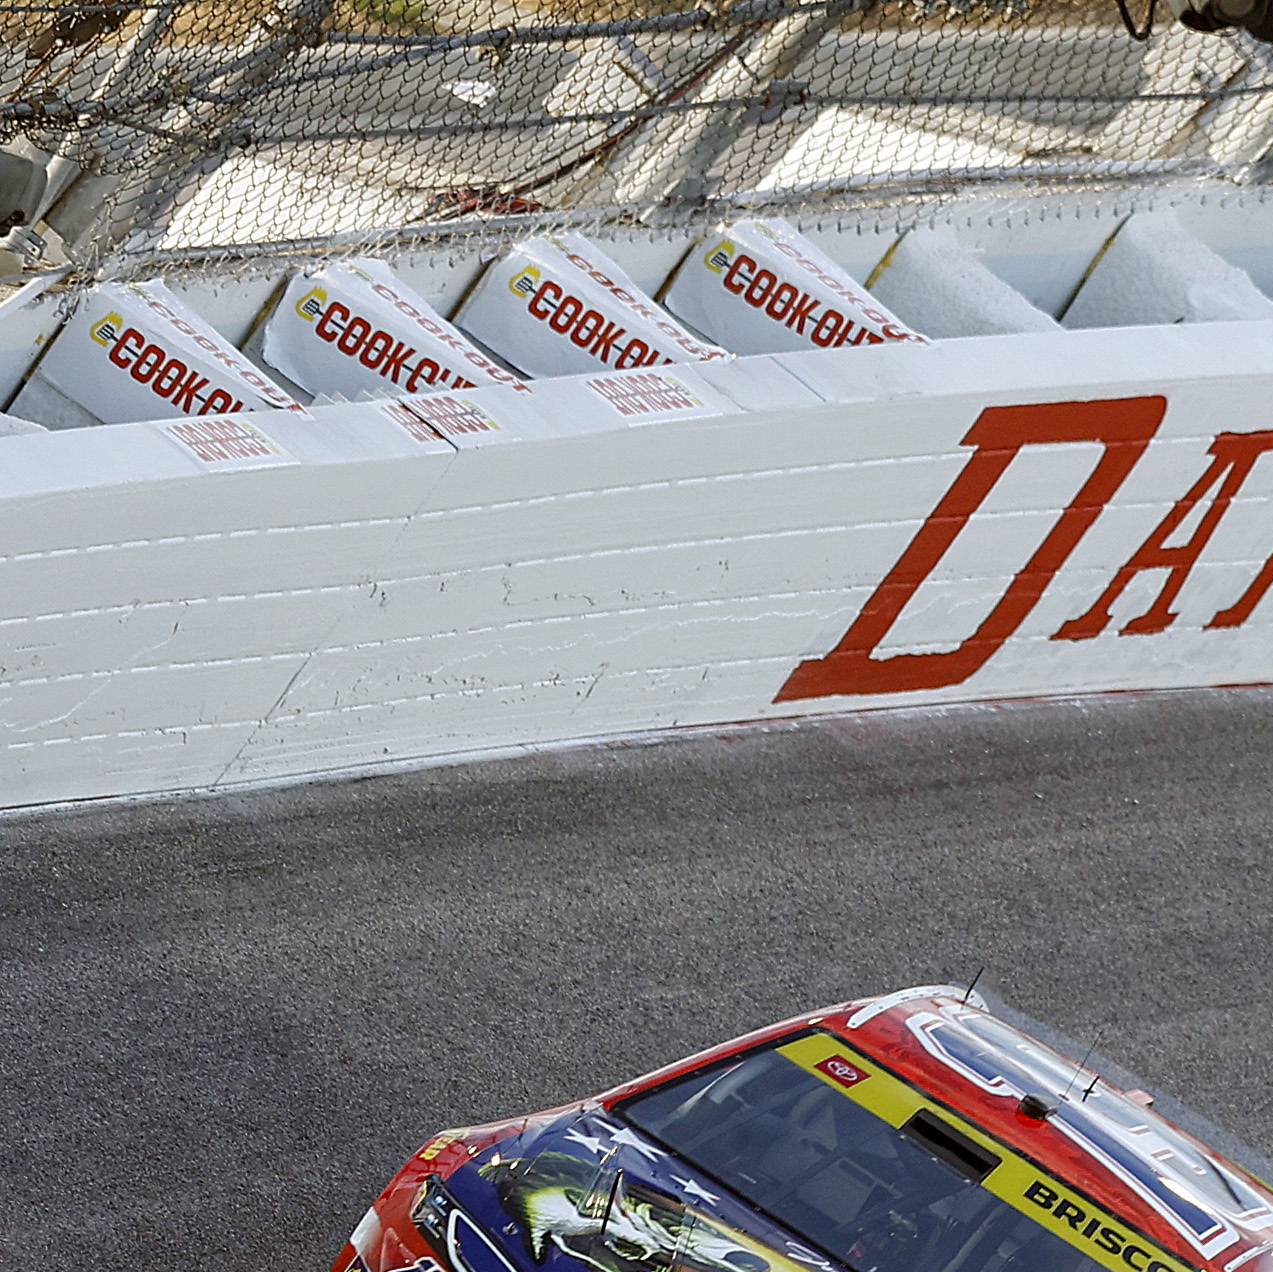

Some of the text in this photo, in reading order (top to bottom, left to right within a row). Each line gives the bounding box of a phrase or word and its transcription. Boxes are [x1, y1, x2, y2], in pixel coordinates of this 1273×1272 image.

[527, 280, 626, 363] COOK
[723, 254, 821, 335] COOK
[109, 328, 210, 414] COOK
[315, 301, 416, 384] COOK
